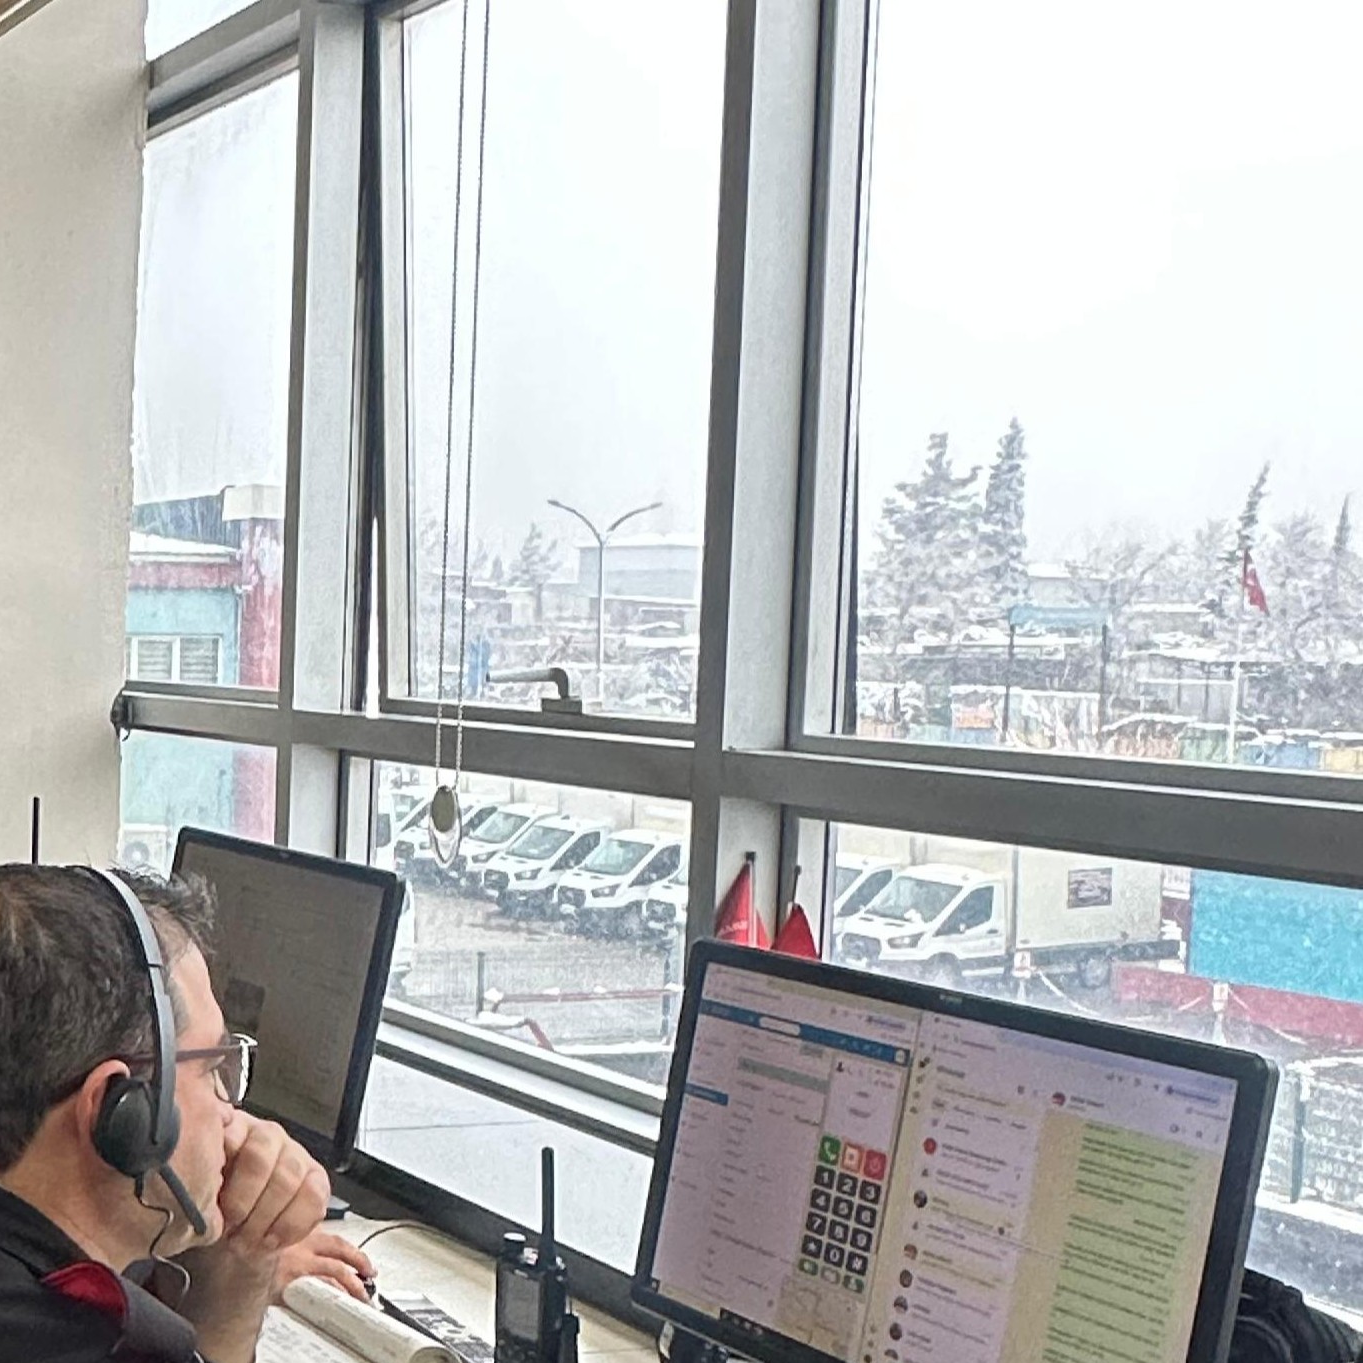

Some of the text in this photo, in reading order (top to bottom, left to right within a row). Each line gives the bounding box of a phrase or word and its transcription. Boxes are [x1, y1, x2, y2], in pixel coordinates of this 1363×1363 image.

[842, 1179, 854, 1193] 2
[865, 1186, 876, 1200] 3
[812, 1217, 823, 1230] 7
